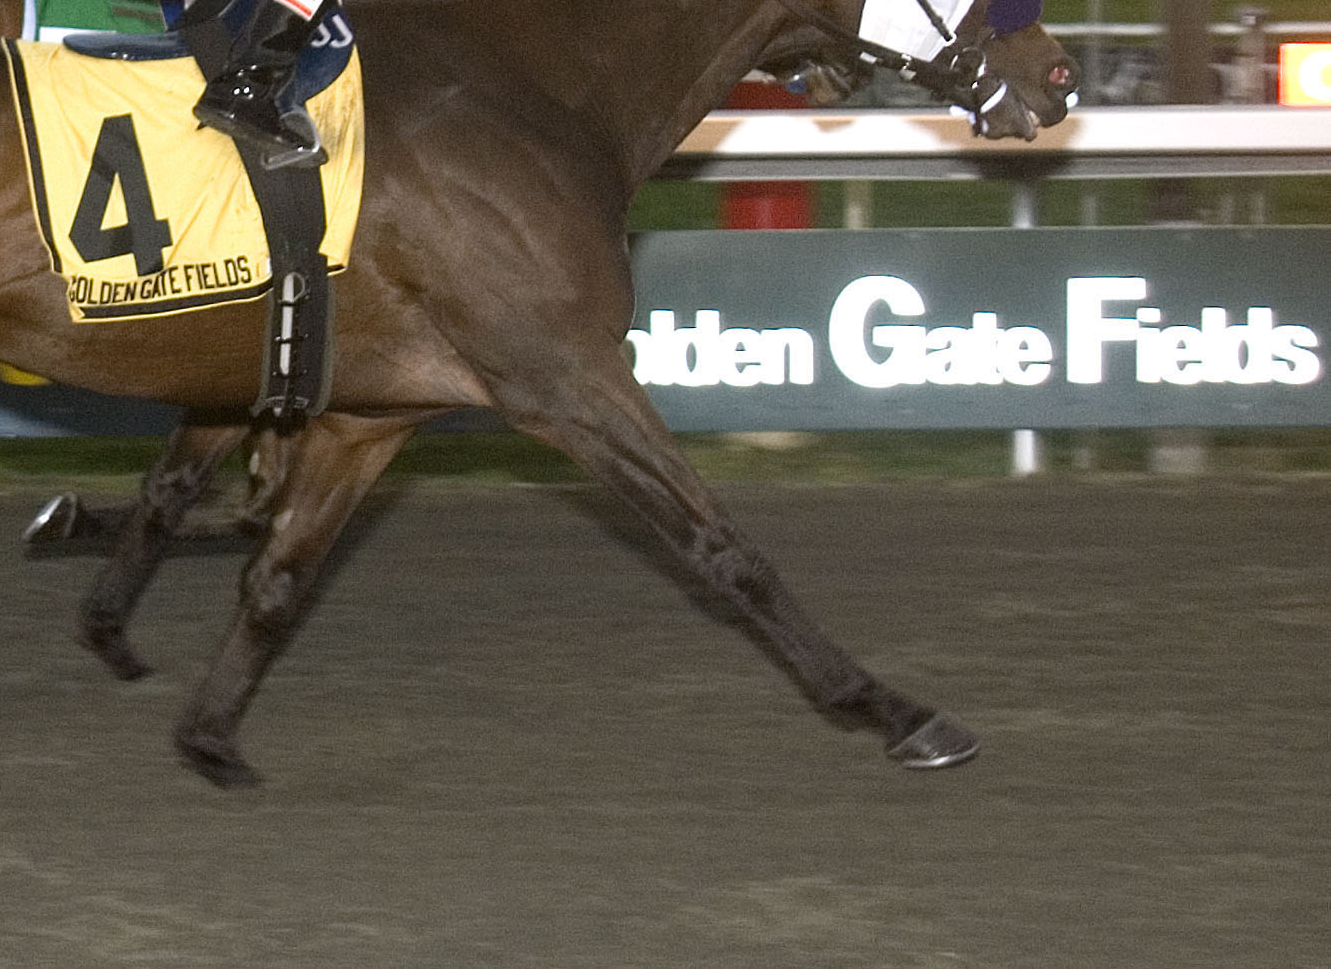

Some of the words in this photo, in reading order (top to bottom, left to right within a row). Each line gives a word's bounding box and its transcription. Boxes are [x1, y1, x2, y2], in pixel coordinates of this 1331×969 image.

[68, 113, 173, 277] 4
[140, 264, 182, 299] GATE
[183, 255, 252, 295] FIELDS
[625, 308, 815, 387] olden
[828, 273, 1055, 389] Gate
[1066, 275, 1322, 386] Fields
